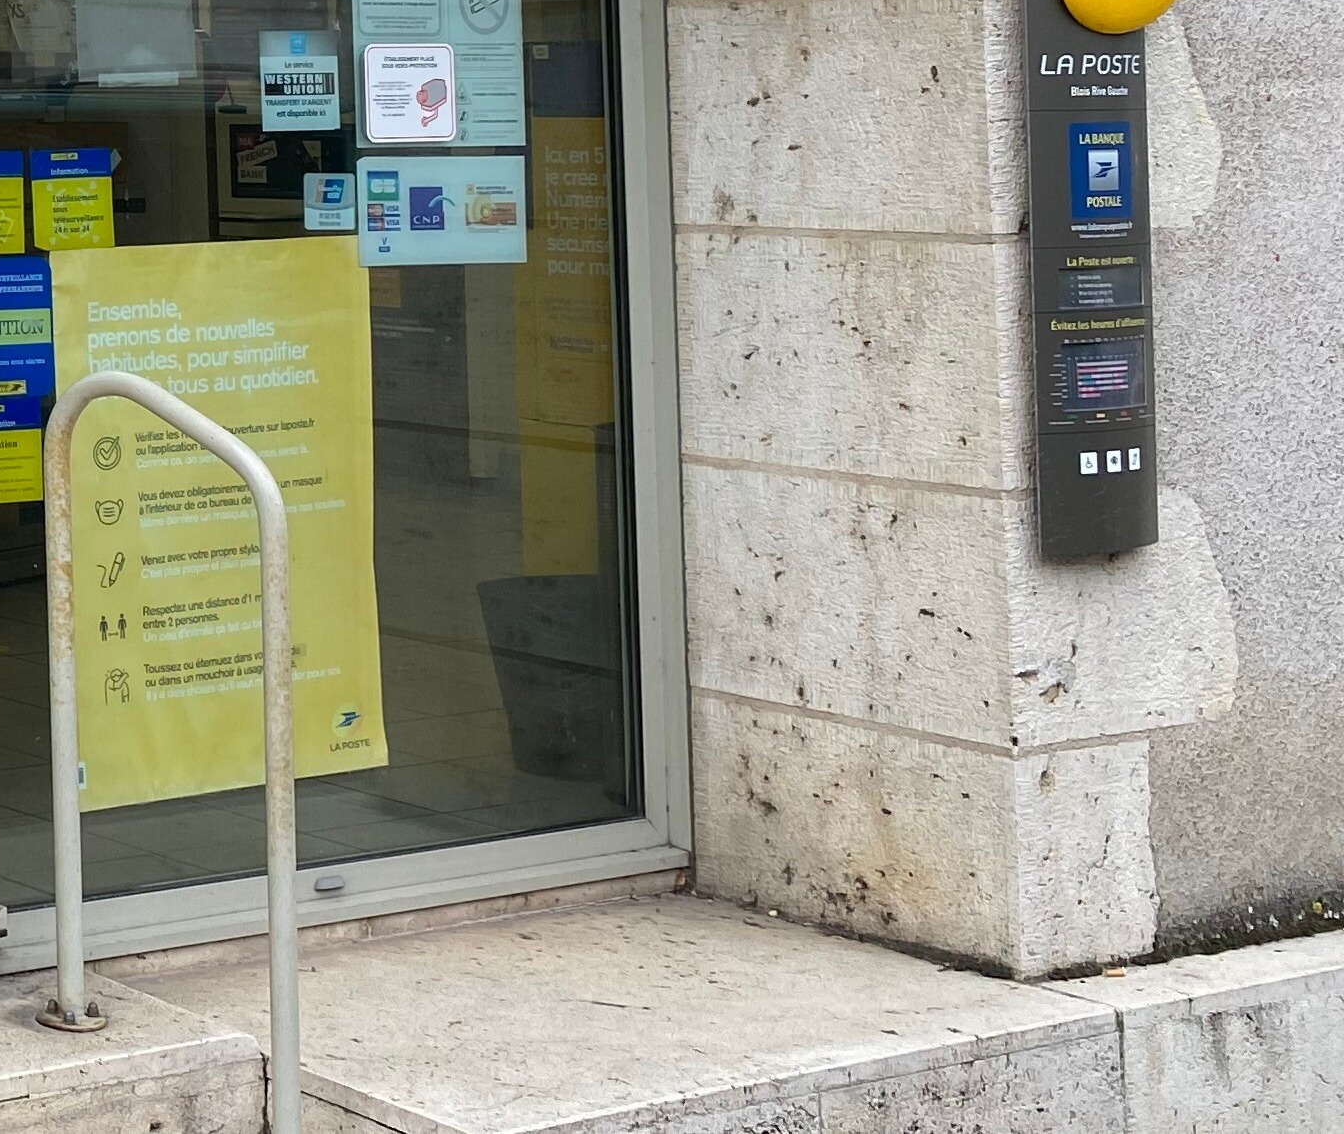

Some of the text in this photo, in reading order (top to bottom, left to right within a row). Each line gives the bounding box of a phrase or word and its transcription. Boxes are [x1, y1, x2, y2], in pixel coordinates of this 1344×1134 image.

[1040, 54, 1141, 75] LA POSTE
[265, 74, 324, 84] WESTERN
[284, 84, 324, 95] UNION
[1079, 133, 1125, 146] LA BANQUE
[1086, 196, 1122, 208] POSTALE
[413, 215, 440, 225] CNP
[1066, 257, 1077, 267] La
[87, 298, 182, 323] Ensemble,
[87, 318, 275, 352] prenons de nouvelles
[88, 341, 309, 373] habitudes, pour simplifier
[167, 375, 209, 395] tous
[214, 375, 236, 392] au
[240, 367, 320, 392] quotidien.
[135, 418, 315, 443] Vérifiez les sur laposte.fr
[136, 441, 198, 456] ou l'application
[138, 491, 157, 501] Vous
[159, 489, 185, 500] devez
[187, 483, 251, 498] obligatoiremen
[292, 475, 323, 487] masque
[145, 500, 182, 514] l'intérieur
[184, 500, 195, 510] de
[197, 500, 208, 509] ce
[209, 495, 240, 507] bureau
[241, 496, 252, 505] de
[141, 556, 165, 566] Venez
[167, 554, 186, 563] avec
[188, 550, 209, 560] votre
[211, 546, 237, 559] propre
[142, 604, 186, 618] Respectez
[188, 602, 204, 611] une
[205, 596, 239, 609] distance
[142, 613, 220, 629] entre 2 personnes.
[144, 653, 252, 674] Toussez ou éternuez dans
[145, 678, 156, 688] ou
[158, 674, 181, 686] dans
[183, 675, 194, 683] un
[195, 668, 235, 682] mouchoir
[330, 739, 370, 752] LA POSTE
